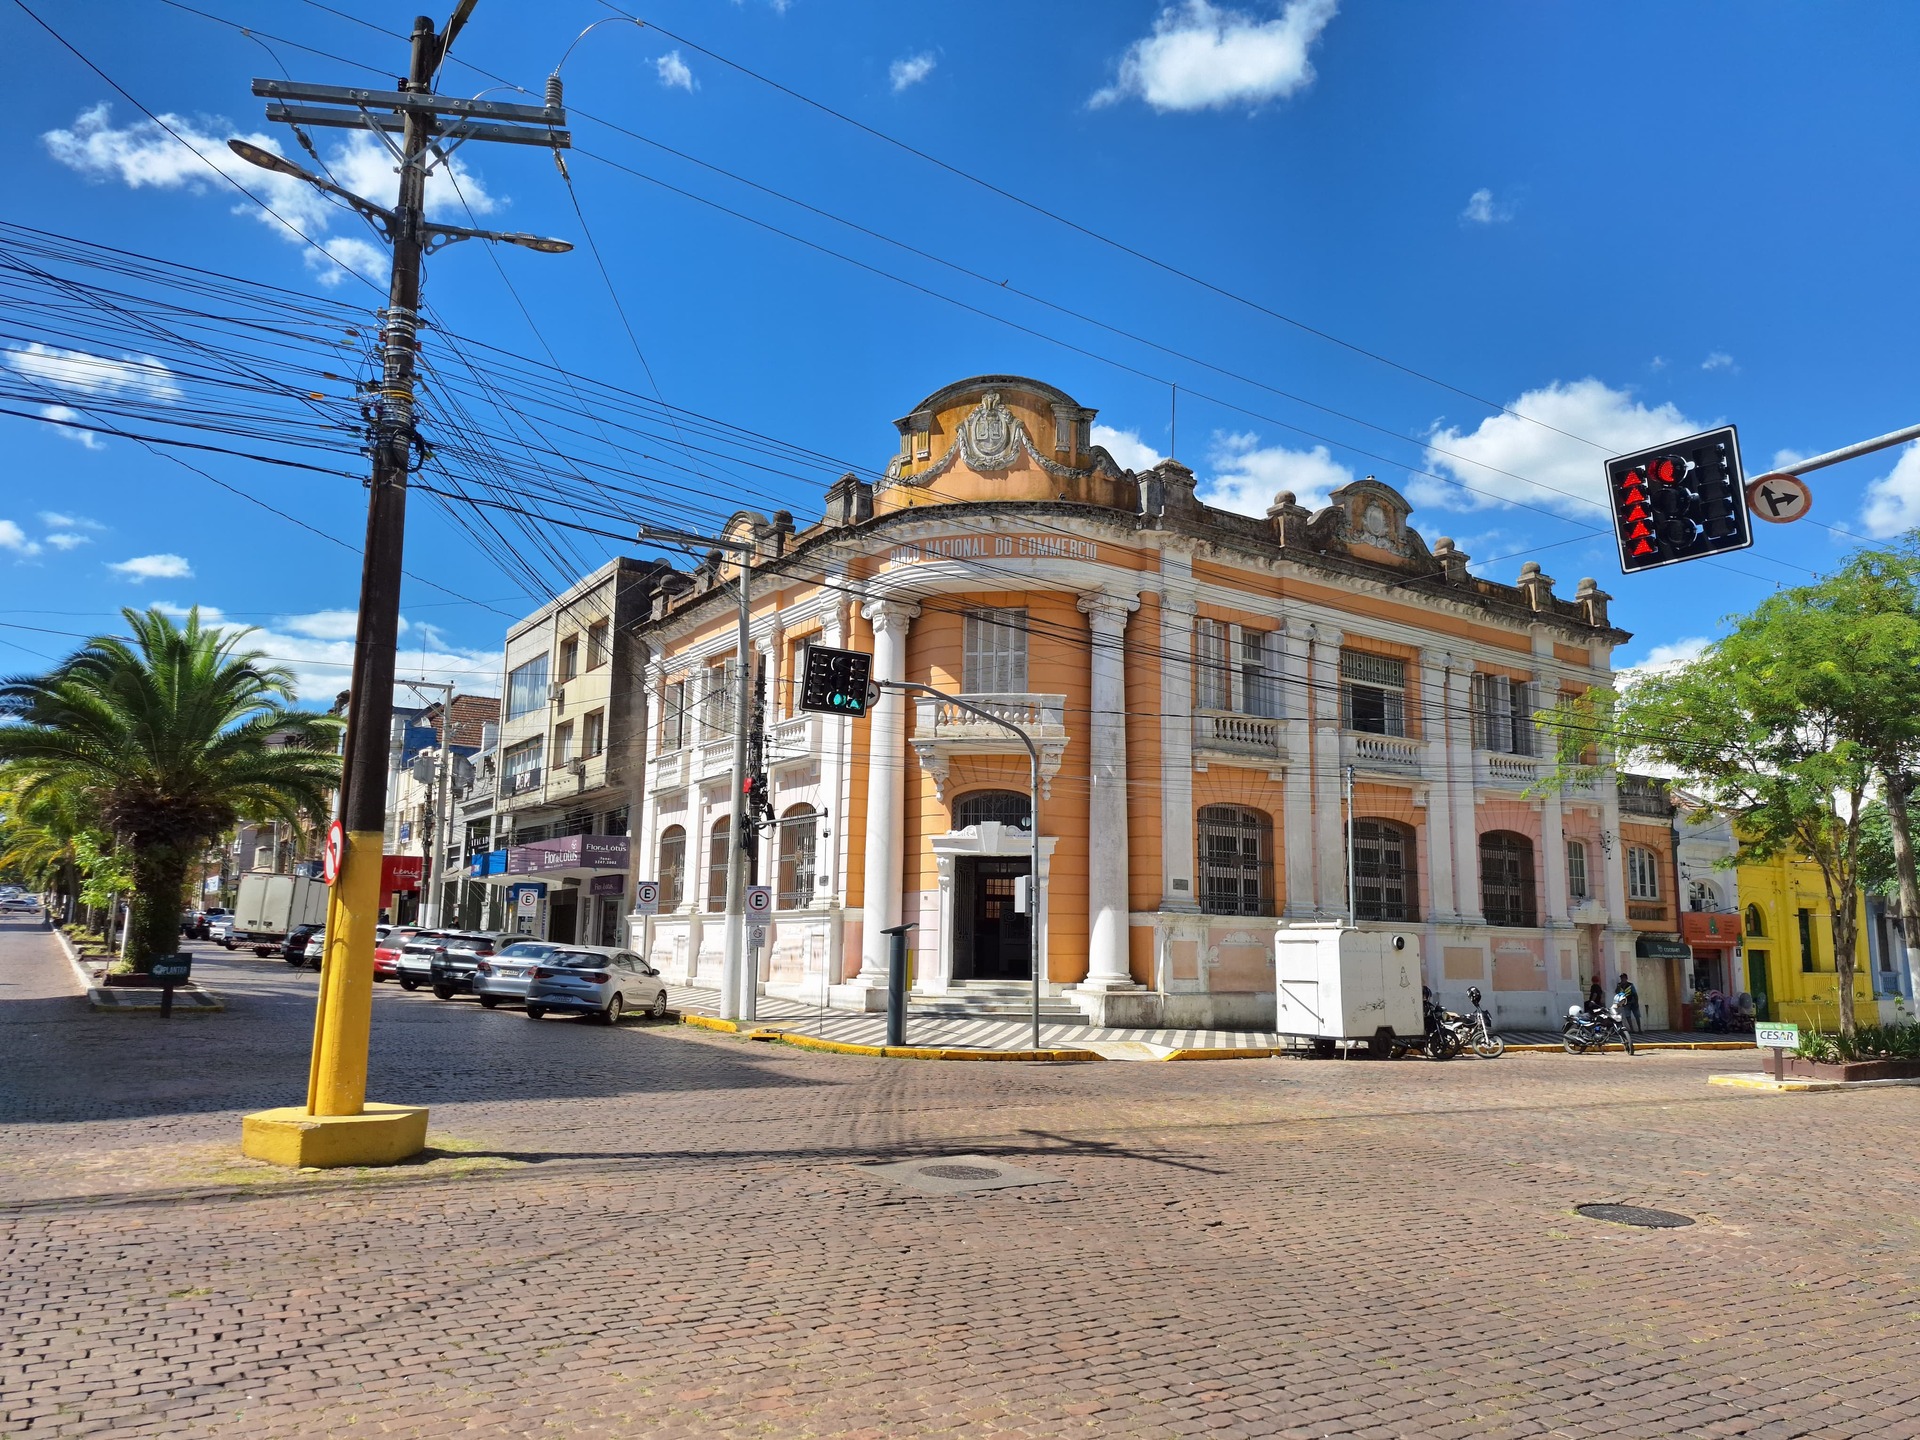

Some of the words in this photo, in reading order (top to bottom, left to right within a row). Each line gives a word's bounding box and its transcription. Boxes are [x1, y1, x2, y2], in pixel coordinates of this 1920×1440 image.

[925, 536, 989, 560] NACIONAL
[995, 536, 1012, 556] DO
[1019, 536, 1097, 561] COMMERCIO
[644, 888, 651, 899] E
[525, 895, 531, 904] E
[755, 894, 763, 906] E
[1760, 1030, 1794, 1041] CESAR
